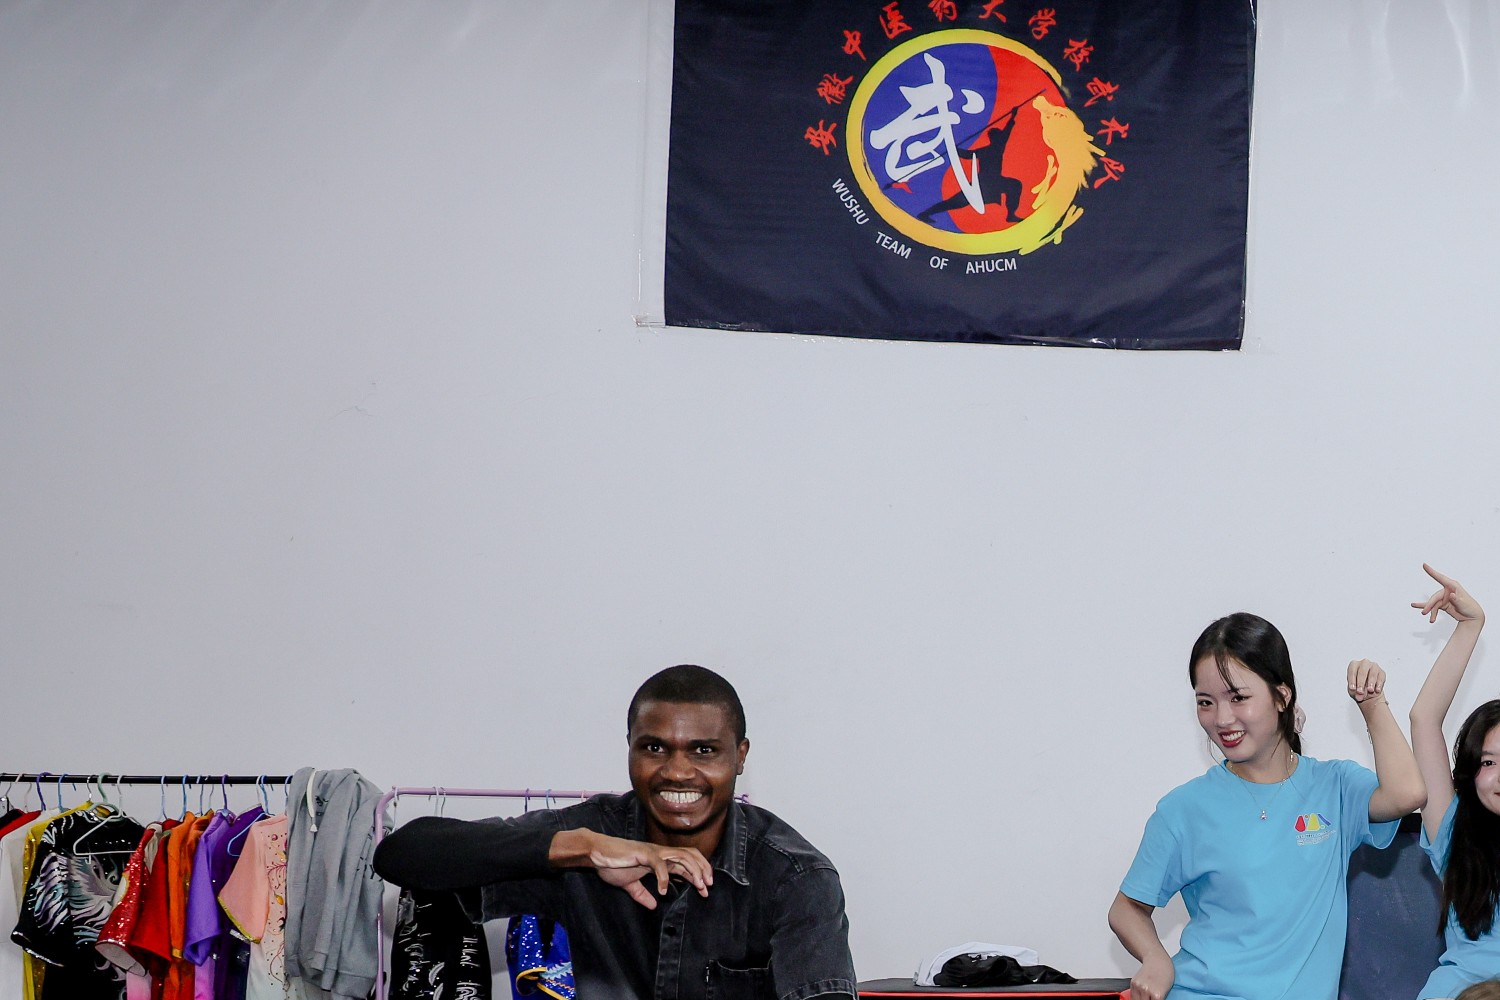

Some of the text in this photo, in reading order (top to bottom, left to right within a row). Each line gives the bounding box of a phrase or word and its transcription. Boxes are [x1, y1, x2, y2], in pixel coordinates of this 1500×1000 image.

[869, 53, 985, 214] 武
[832, 178, 1017, 274] WUSHU TEAM OF AHUCM
